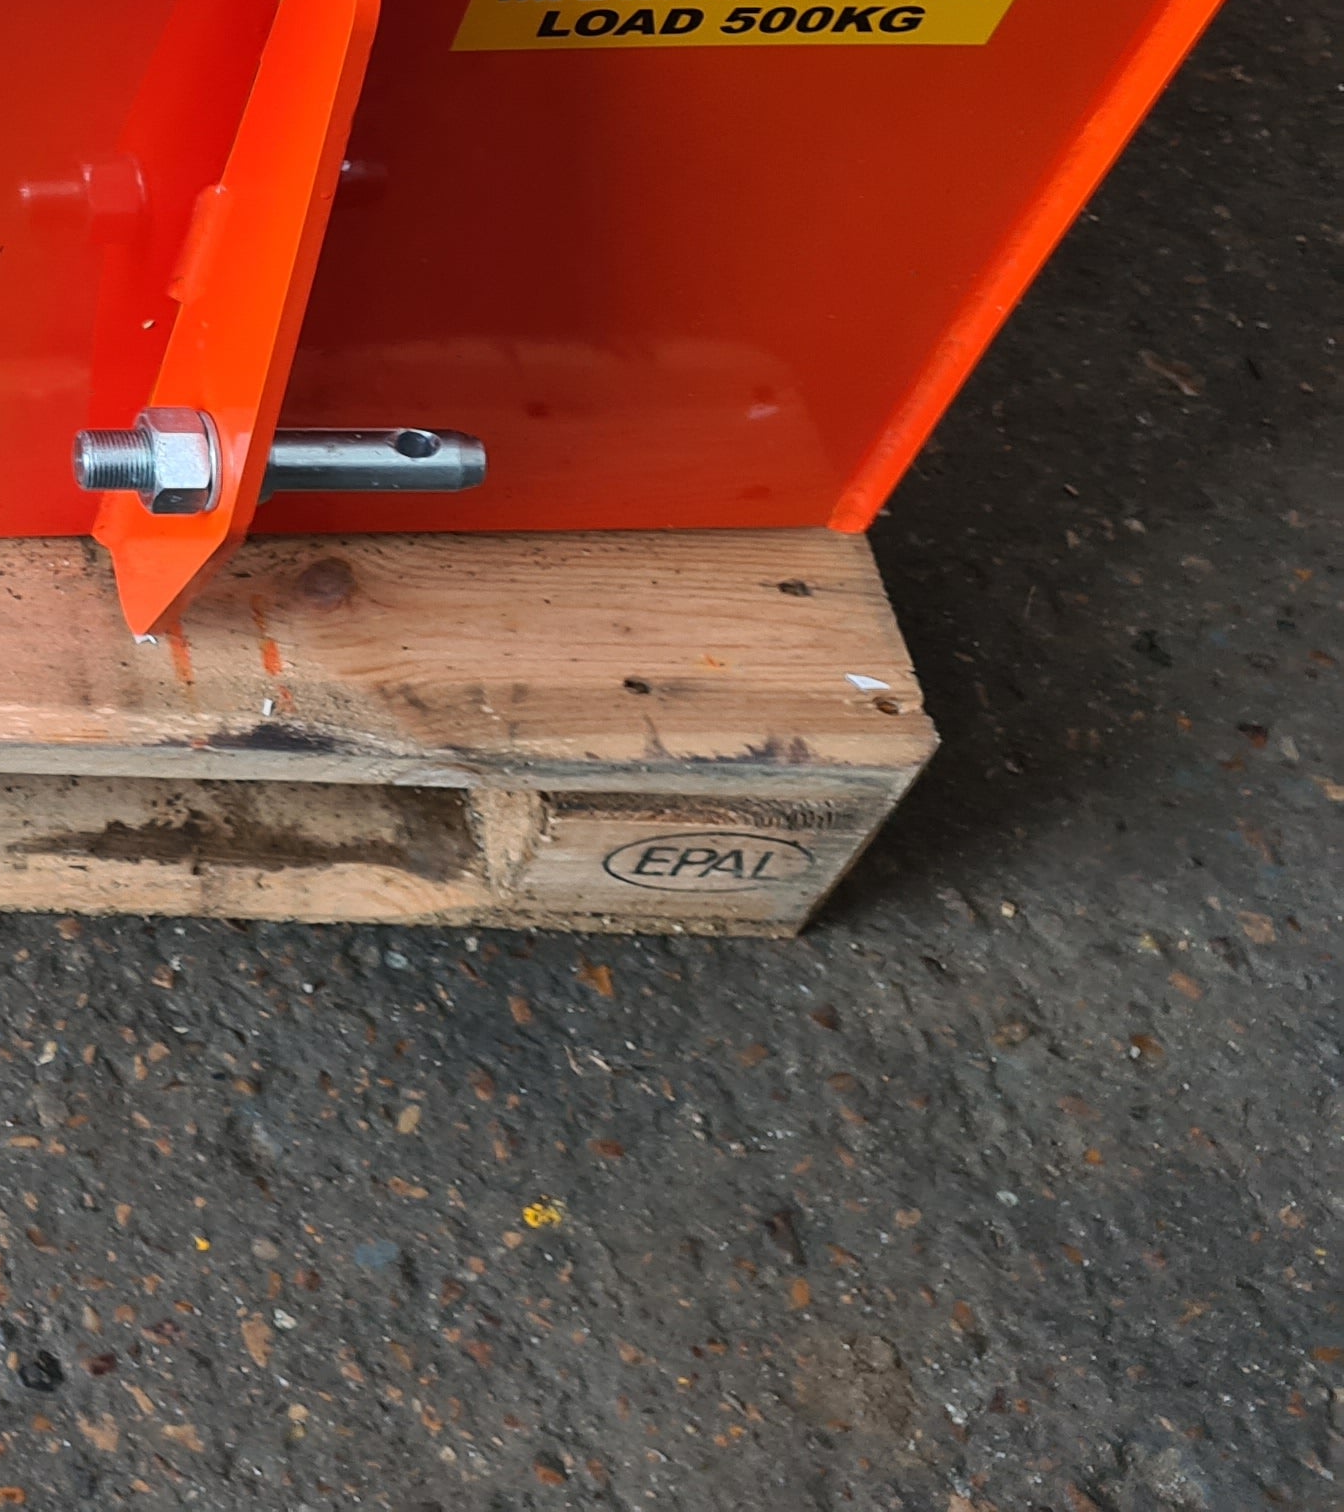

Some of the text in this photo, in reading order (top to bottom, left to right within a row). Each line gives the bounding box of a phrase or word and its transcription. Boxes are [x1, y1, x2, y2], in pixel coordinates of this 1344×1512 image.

[535, 5, 927, 38] LOAD 500KG
[631, 846, 780, 881] EPAL
